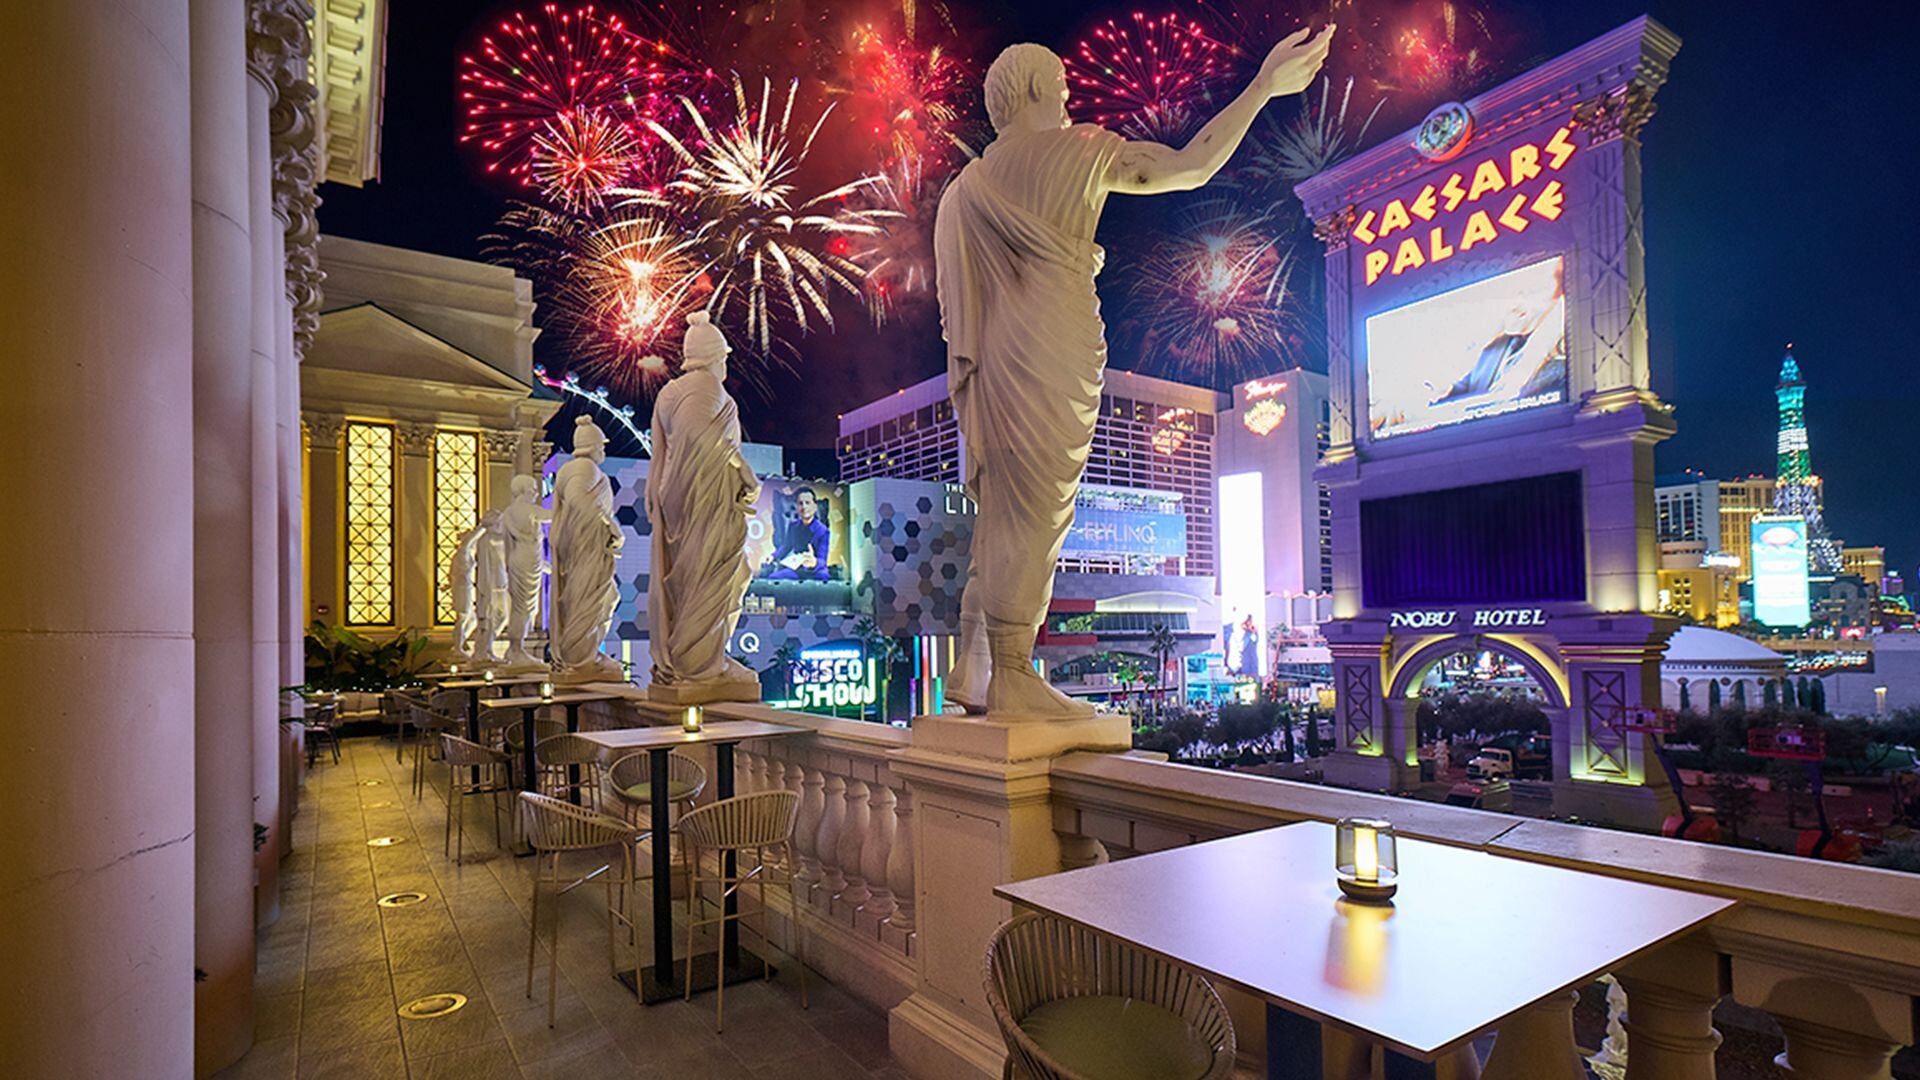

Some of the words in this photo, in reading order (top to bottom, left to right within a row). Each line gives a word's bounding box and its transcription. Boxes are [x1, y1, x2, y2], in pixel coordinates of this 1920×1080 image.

[1353, 127, 1577, 244] CAESARS
[1365, 180, 1565, 286] PALACE
[1389, 611, 1457, 628] NOBU
[1473, 609, 1548, 626] HOTEL
[790, 659, 864, 684] DISCO
